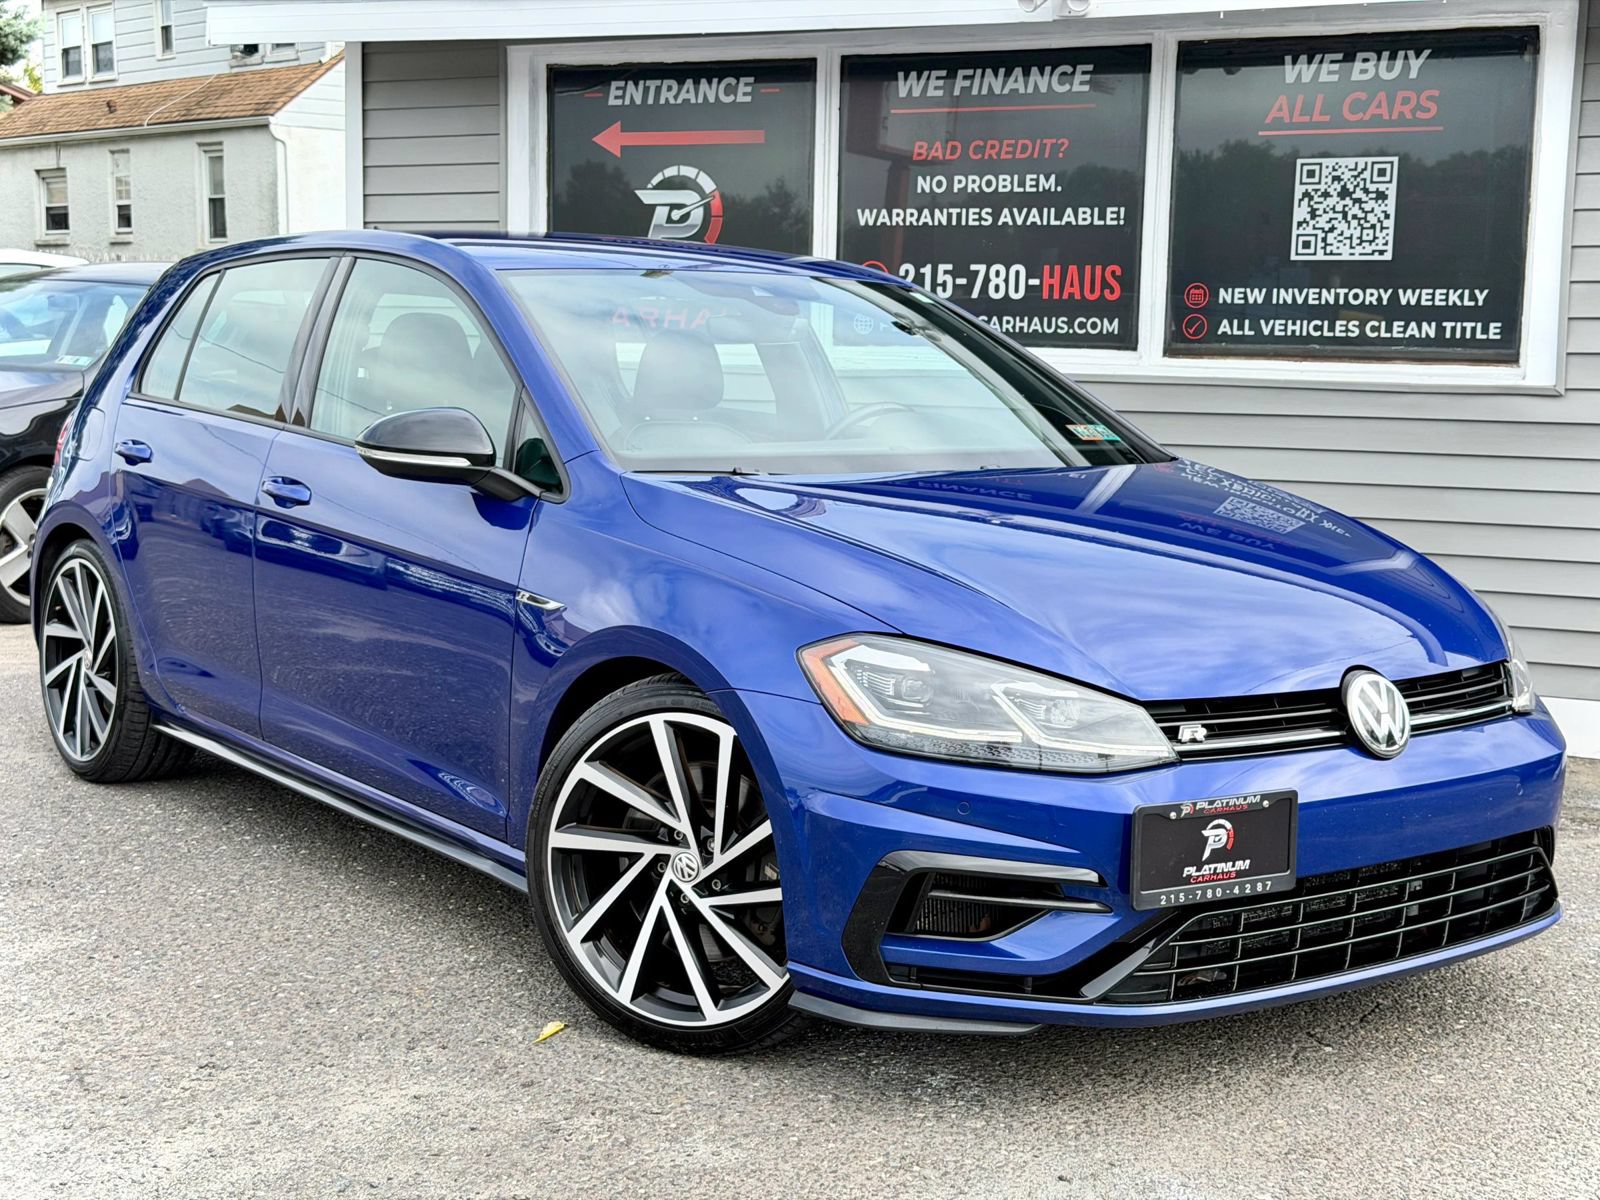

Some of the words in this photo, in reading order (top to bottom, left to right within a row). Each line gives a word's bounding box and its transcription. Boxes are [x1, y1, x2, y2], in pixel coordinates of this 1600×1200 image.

[1284, 53, 1344, 84] WE
[1350, 49, 1432, 81] BUY
[897, 69, 948, 98] WE
[953, 64, 1094, 96] FINANCE
[607, 77, 755, 106] ENTRANCE
[1264, 94, 1331, 124] ALL
[1341, 89, 1440, 121] CARS
[912, 140, 961, 160] BAD
[968, 138, 1071, 160] CREDIT?
[916, 175, 947, 193] NO
[953, 174, 1062, 193] PROBLEM.
[857, 208, 993, 226] WARRANTIES
[997, 207, 1125, 225] AVAILABLE!
[1218, 287, 1267, 304] NEW
[1271, 287, 1393, 306] INVENTORY
[1398, 288, 1489, 306] WEEKLY
[1216, 319, 1255, 336] ALL
[1259, 319, 1359, 338] VEHICLES
[1364, 320, 1437, 339] CLEAN
[1441, 321, 1502, 340] TITLE
[1178, 724, 1207, 742] R
[1195, 795, 1261, 810] PLATINUM
[1203, 804, 1249, 814] CARHAUS
[1182, 859, 1251, 877] PLATINUM
[1190, 871, 1237, 883] CARHAUS
